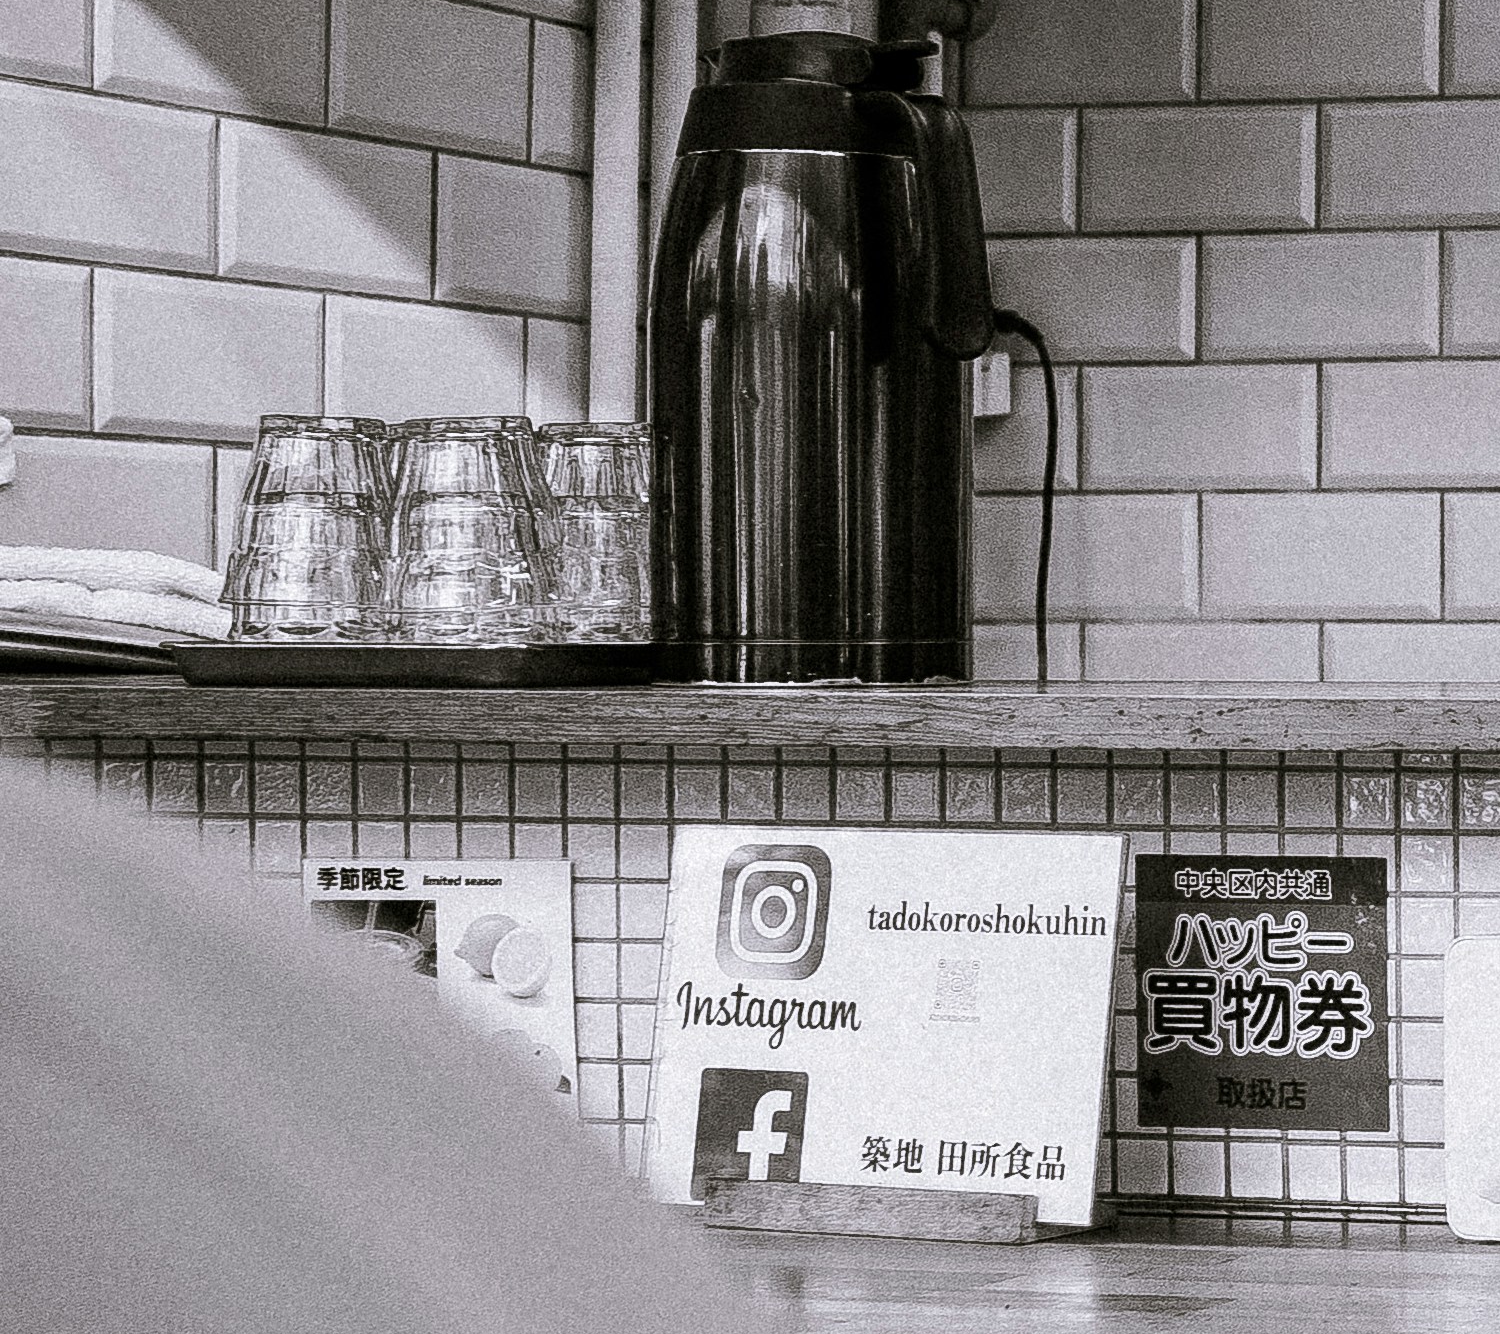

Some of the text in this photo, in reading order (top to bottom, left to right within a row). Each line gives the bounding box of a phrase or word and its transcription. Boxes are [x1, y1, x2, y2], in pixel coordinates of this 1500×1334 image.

[317, 867, 405, 892] 季節限定
[1175, 869, 1333, 900] 中央区内共通
[867, 901, 1107, 936] tadokoroshokuhin
[1166, 910, 1354, 971] ハッピー
[676, 981, 862, 1050] Instagram
[1144, 968, 1375, 1060] 買物券
[1217, 1077, 1307, 1111] 取扱店
